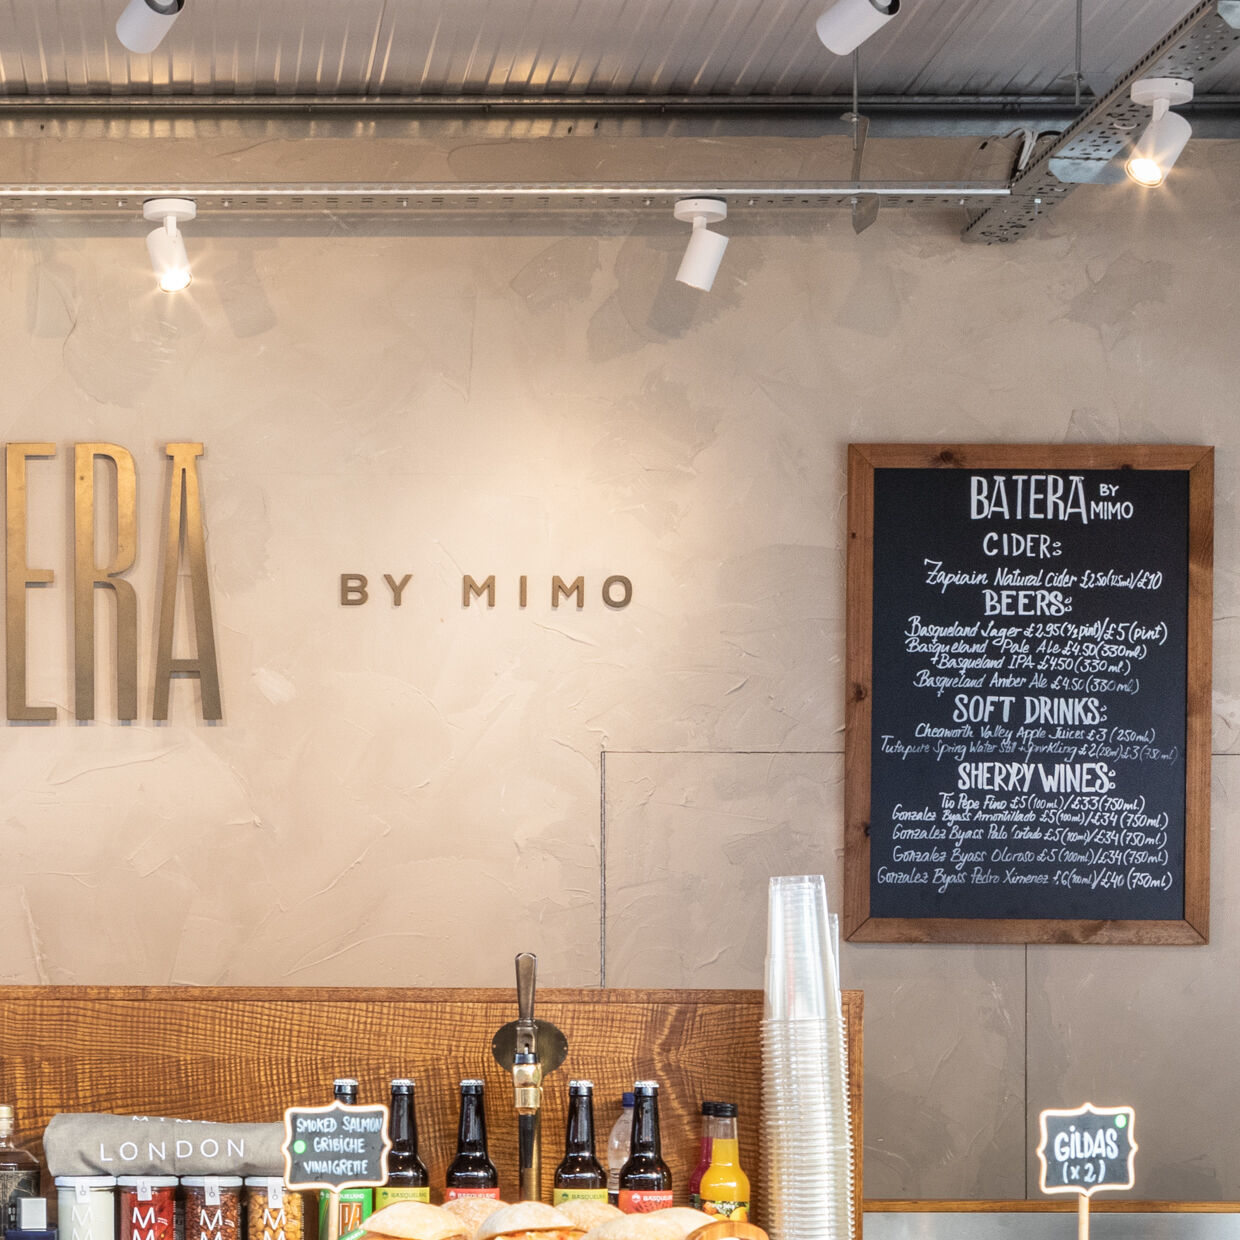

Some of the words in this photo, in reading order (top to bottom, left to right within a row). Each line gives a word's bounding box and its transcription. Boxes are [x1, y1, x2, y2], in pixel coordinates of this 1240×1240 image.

[970, 474, 1088, 525] BATERA
[1099, 484, 1120, 498] BY
[1091, 501, 1134, 520] MIMO
[994, 567, 1044, 587] Natural
[1045, 568, 1077, 588] Cider
[339, 573, 413, 607] BY
[462, 574, 634, 609] MIMO
[1001, 639, 1030, 654] Pale
[1036, 638, 1061, 654] Ale
[1007, 655, 1036, 669] IPA
[989, 671, 1027, 688] Amber
[1029, 672, 1048, 689] Ale
[953, 694, 1015, 723] SOFT
[980, 725, 1014, 744] Valley
[1016, 726, 1047, 744] Apple
[969, 740, 998, 753] Water
[958, 762, 1033, 792] SHERRY
[938, 792, 955, 809] Tio
[957, 793, 980, 813] Pepe
[983, 794, 1008, 810] Fino
[892, 804, 937, 821] Gonzalez
[942, 810, 971, 826] Byass
[892, 823, 947, 840] Gonzalez
[949, 825, 985, 847] Byass
[987, 823, 1008, 840] Palo
[893, 845, 947, 862] Gonzalez
[950, 848, 987, 871] Byass
[991, 846, 1036, 862] Oloroso
[877, 866, 929, 884] Gonzalez
[932, 868, 967, 894] Byass
[970, 866, 1000, 884] Pedro
[296, 1118, 337, 1133] SMOKED
[342, 1116, 383, 1133] SALMON
[100, 1138, 245, 1162] LONDON
[132, 1207, 155, 1228] M
[200, 1209, 223, 1231] M
[263, 1208, 286, 1230] M
